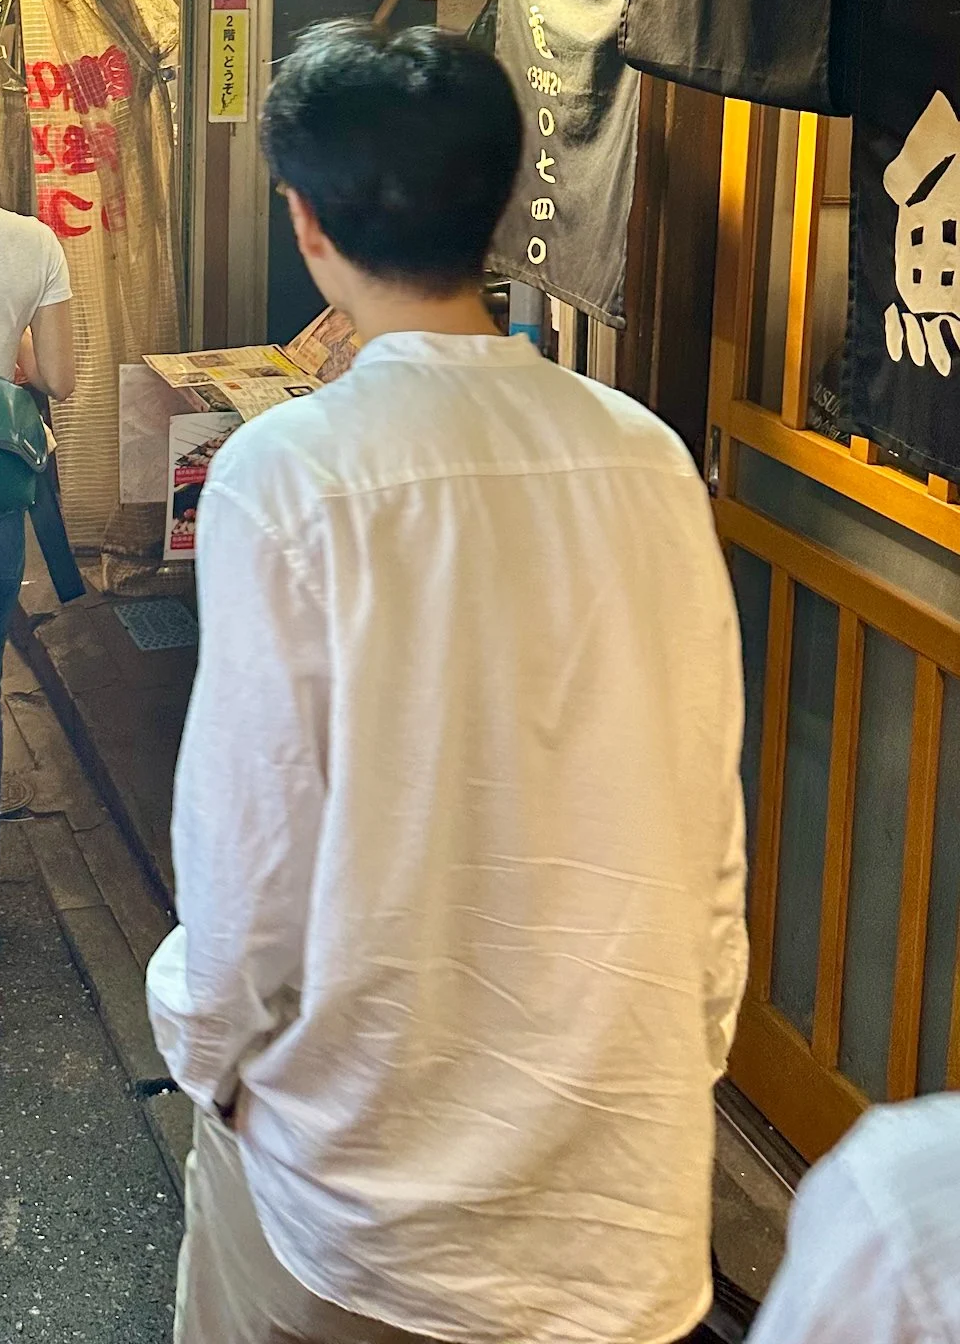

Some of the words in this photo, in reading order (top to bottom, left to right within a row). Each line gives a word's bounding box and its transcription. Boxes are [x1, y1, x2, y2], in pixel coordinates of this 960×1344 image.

[223, 15, 236, 96] 2階へどうぞ
